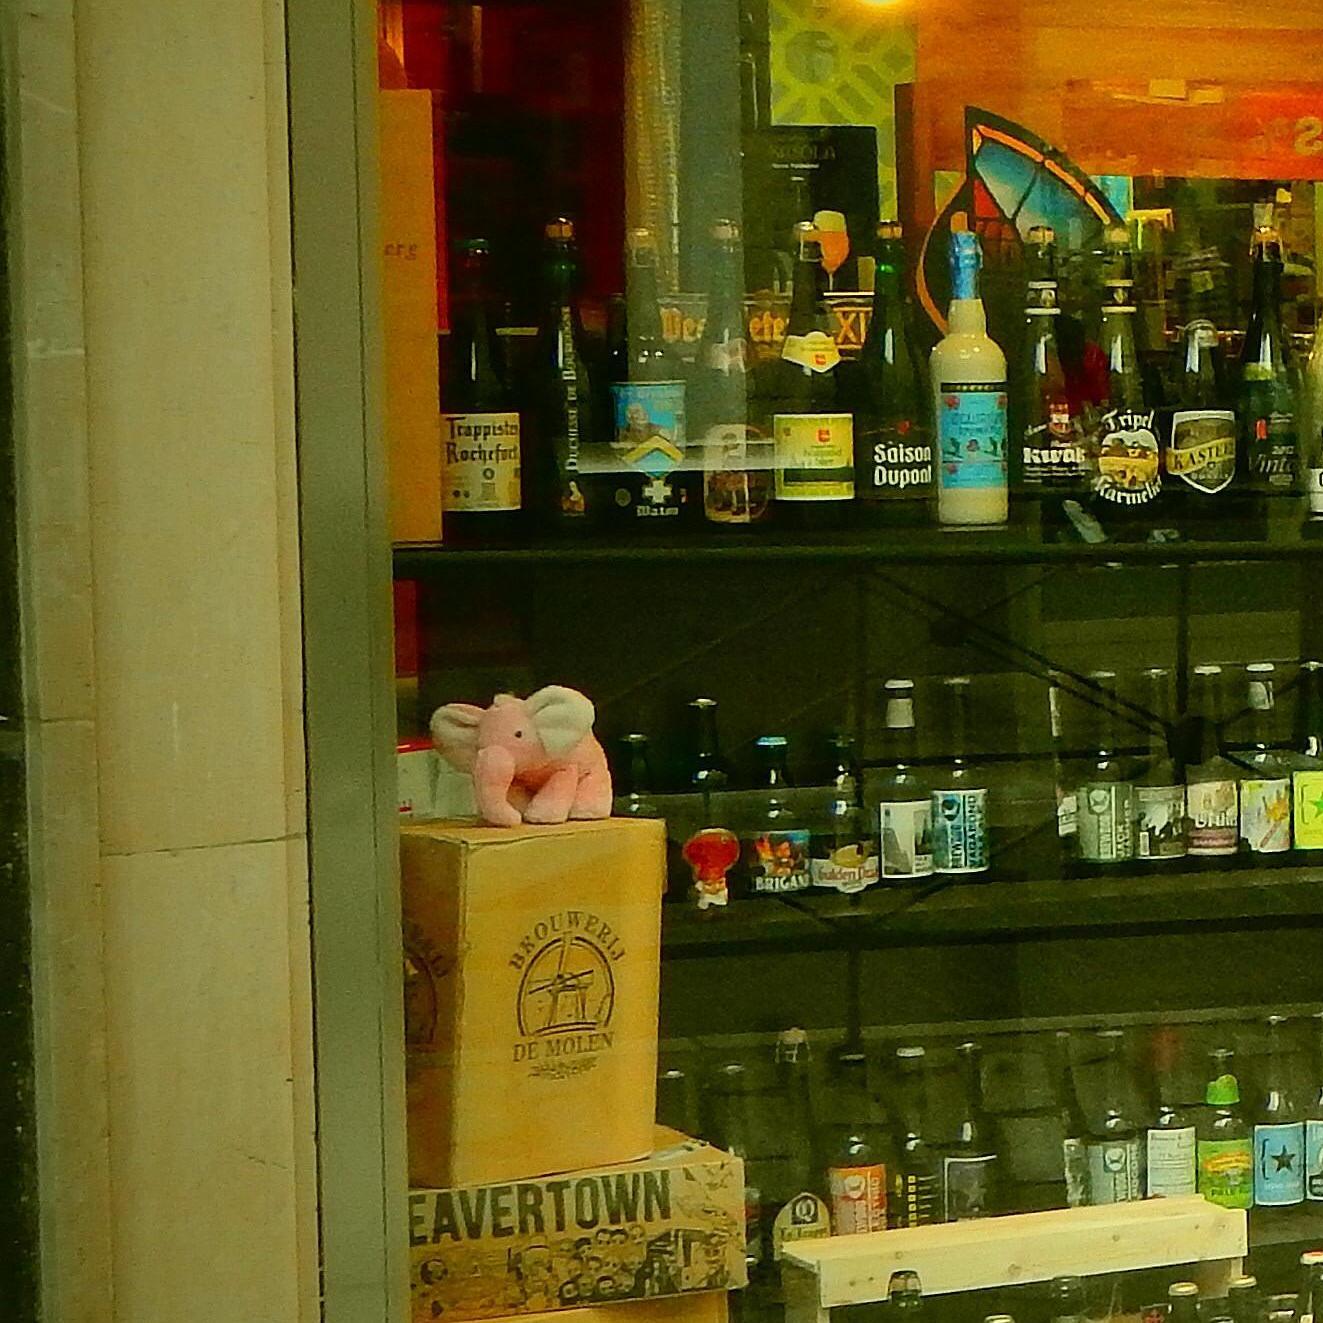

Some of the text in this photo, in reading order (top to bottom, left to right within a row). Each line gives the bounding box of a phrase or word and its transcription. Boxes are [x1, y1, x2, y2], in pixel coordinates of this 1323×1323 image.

[1101, 408, 1155, 431] Tripel
[874, 443, 931, 464] Saison
[508, 911, 626, 970] BROUWERIJ
[513, 1032, 614, 1062] DE MOLEN
[409, 1169, 672, 1248] EAVERTOWN
